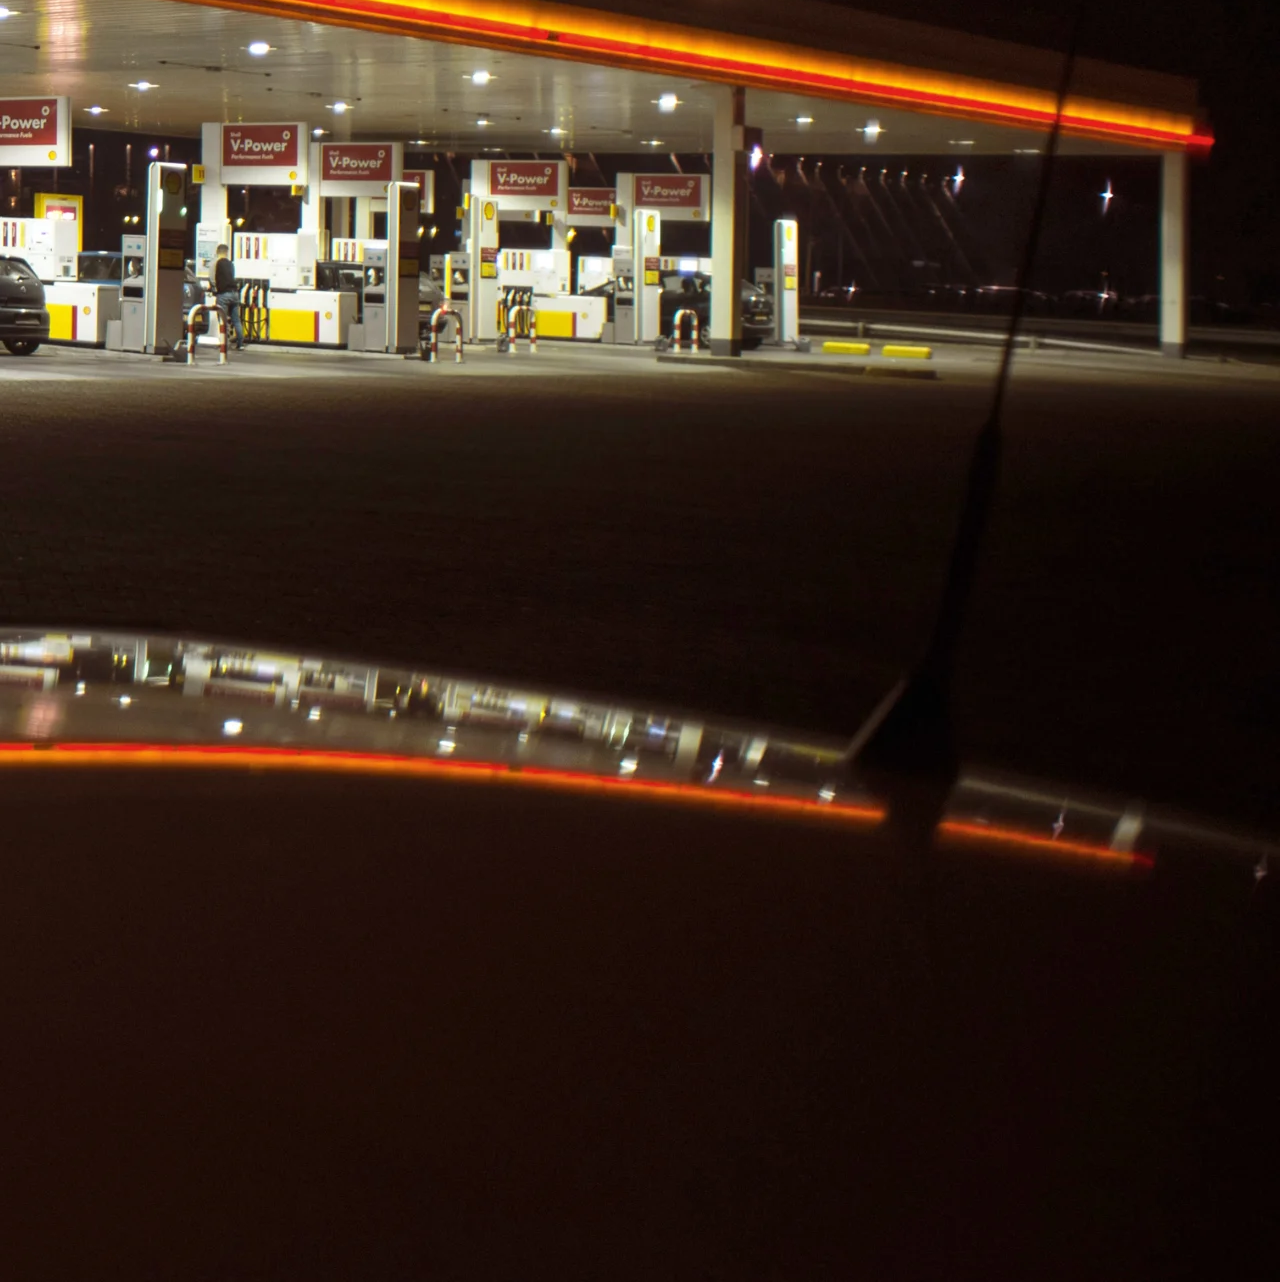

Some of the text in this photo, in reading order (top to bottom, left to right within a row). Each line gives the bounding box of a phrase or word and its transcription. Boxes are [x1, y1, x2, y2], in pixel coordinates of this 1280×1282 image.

[230, 138, 288, 152] V-Power
[329, 157, 383, 168] V-Power
[497, 173, 550, 185] V-Power
[642, 186, 693, 197] V-Power
